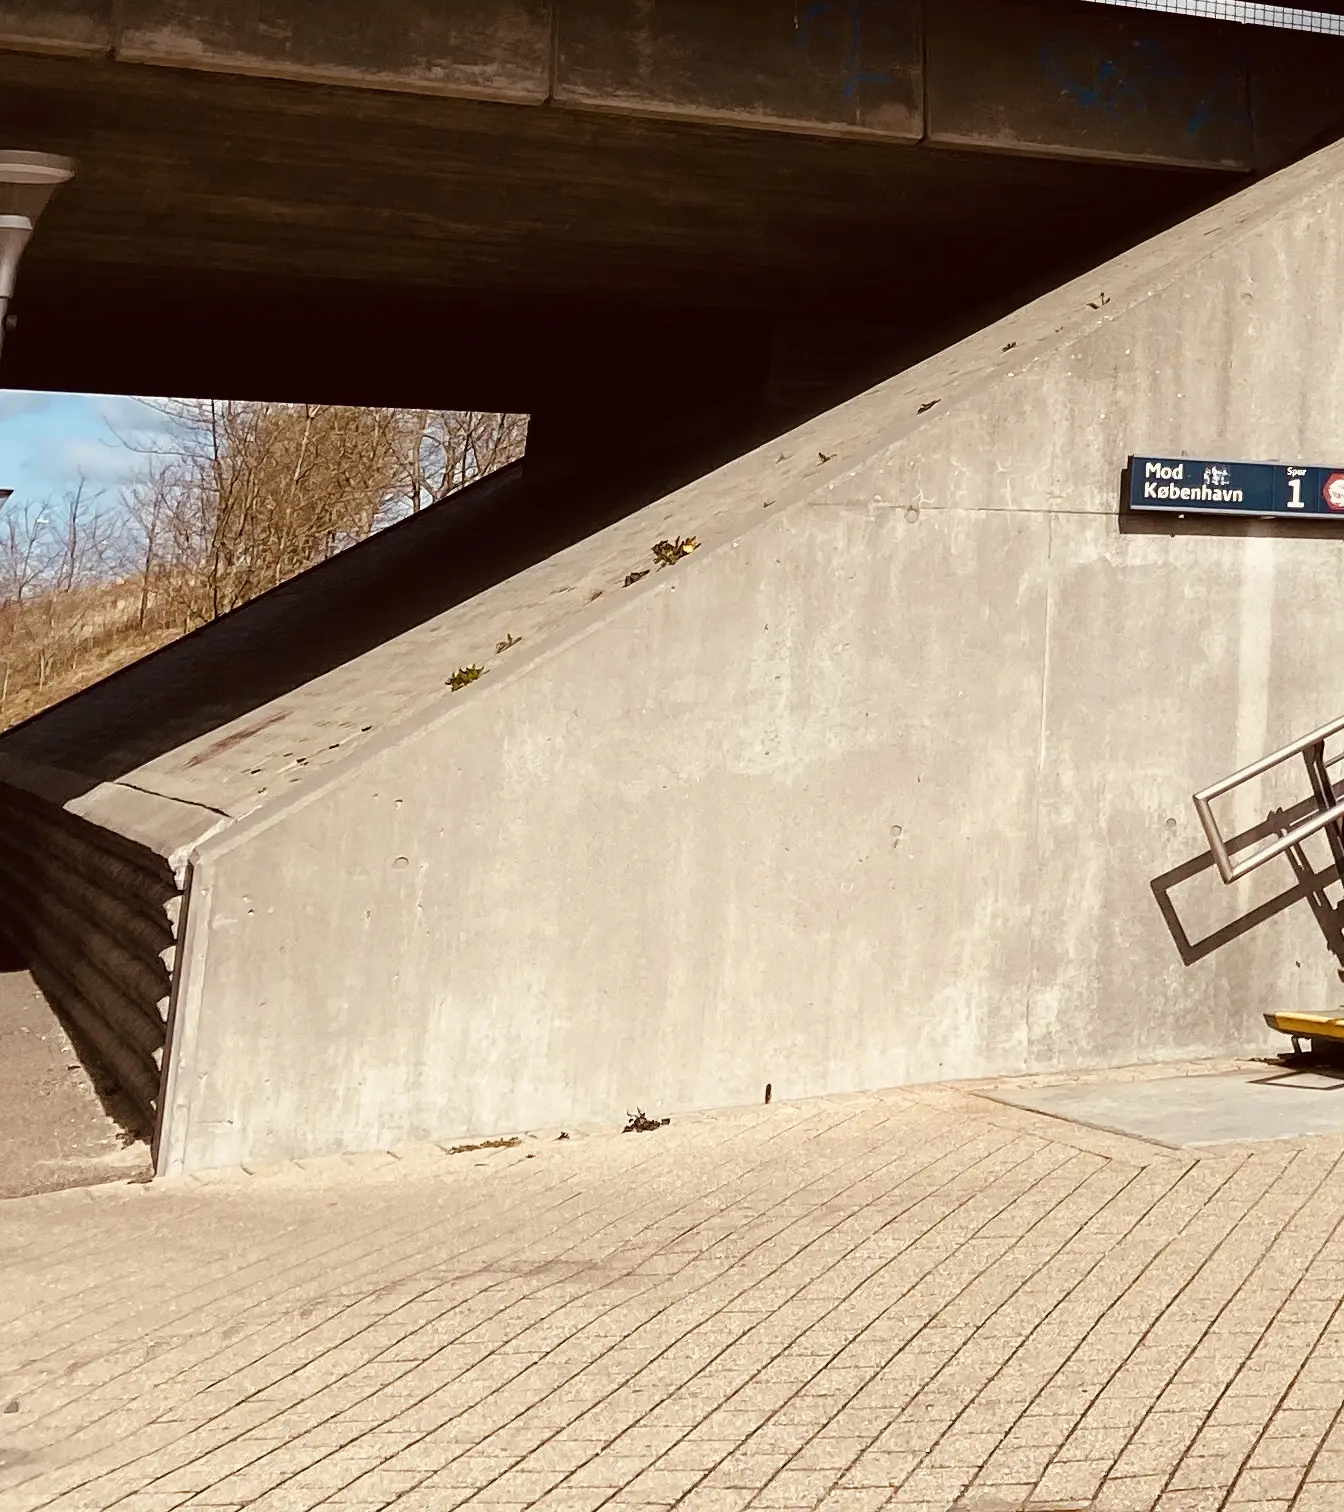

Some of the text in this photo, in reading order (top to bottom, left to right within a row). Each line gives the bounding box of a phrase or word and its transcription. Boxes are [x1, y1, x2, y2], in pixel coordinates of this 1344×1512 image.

[1145, 462, 1184, 480] Mod
[1287, 467, 1307, 477] Spor
[1143, 481, 1243, 502] København
[1287, 479, 1305, 508] 1
